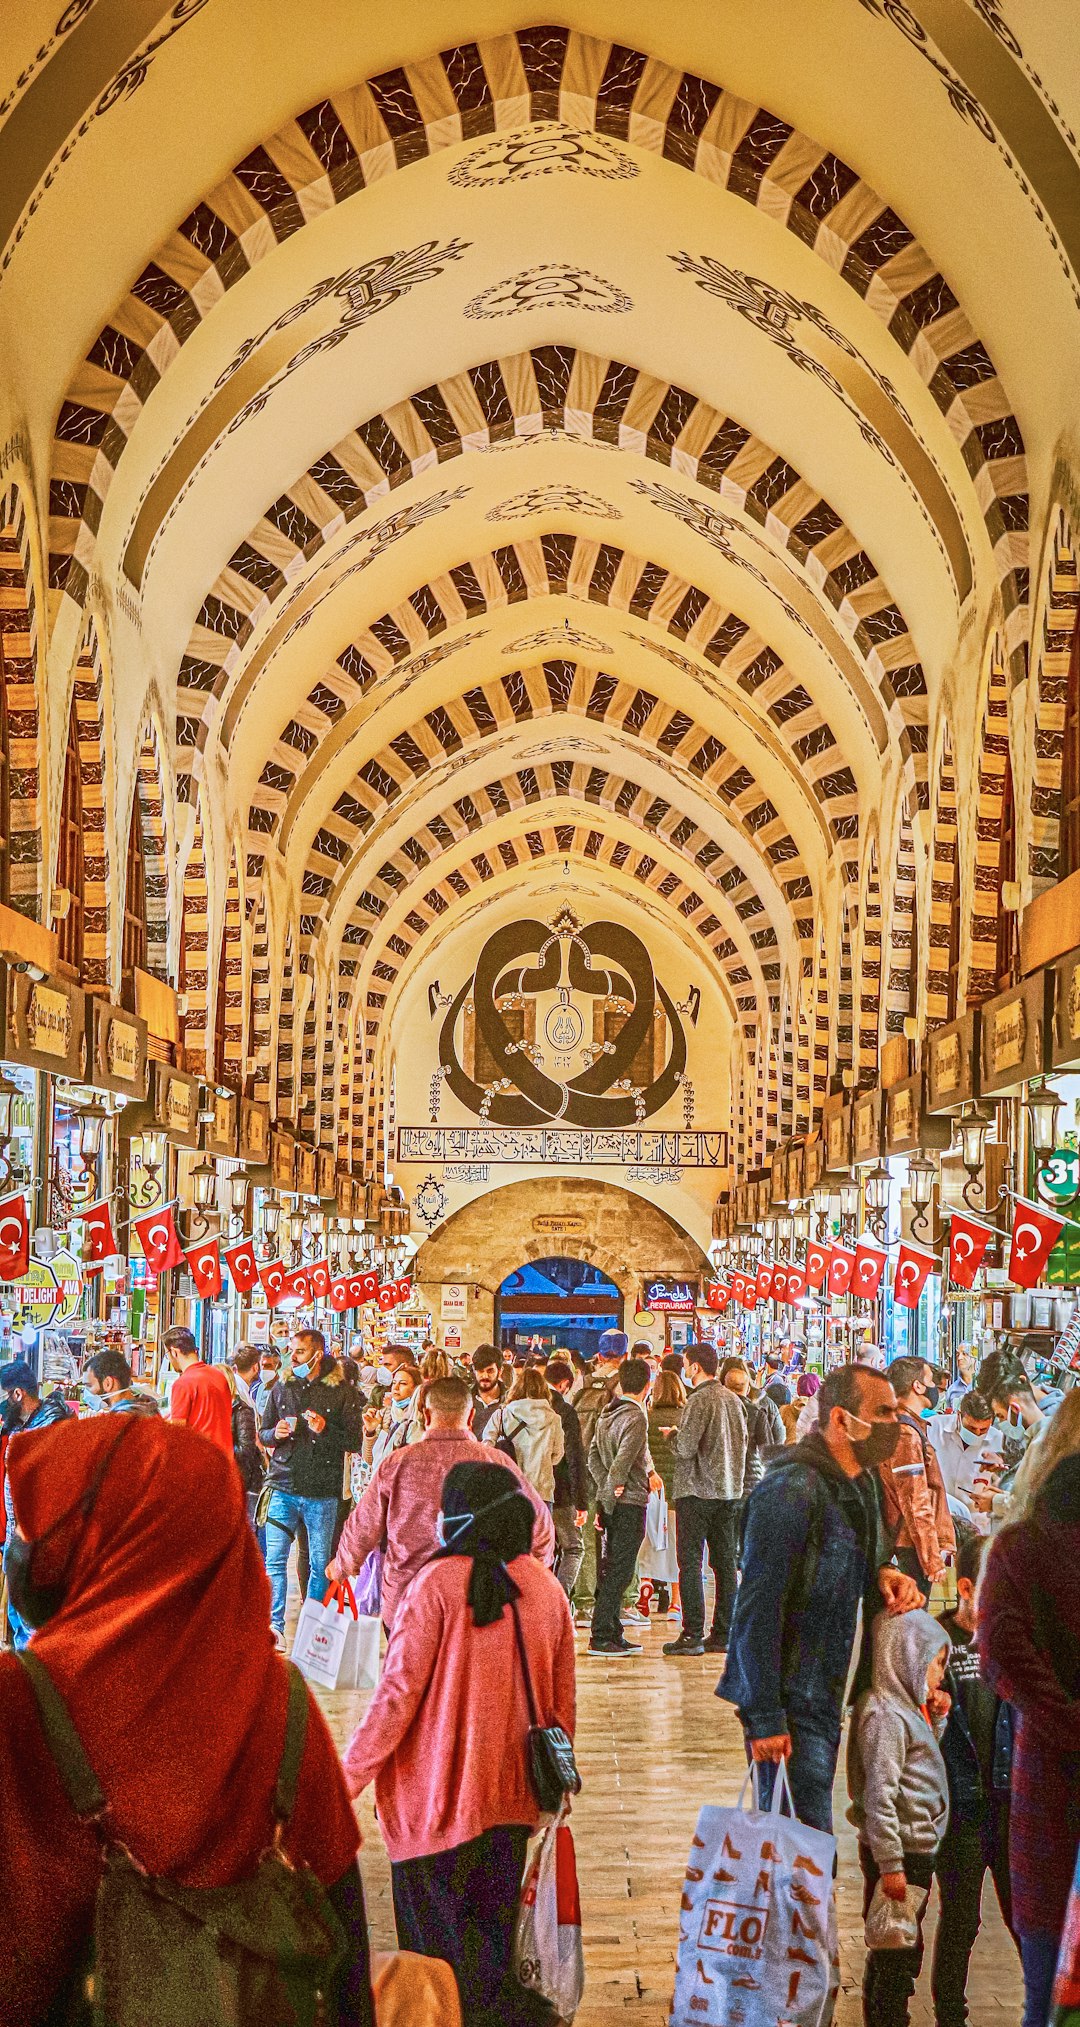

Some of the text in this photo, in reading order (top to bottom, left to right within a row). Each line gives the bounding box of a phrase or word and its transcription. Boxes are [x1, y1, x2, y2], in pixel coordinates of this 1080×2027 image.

[23, 1287, 58, 1304] DELIGHT
[648, 1284, 694, 1301] Pandeli
[649, 1302, 693, 1310] RESTAURANT
[704, 1909, 763, 1944] FLO
